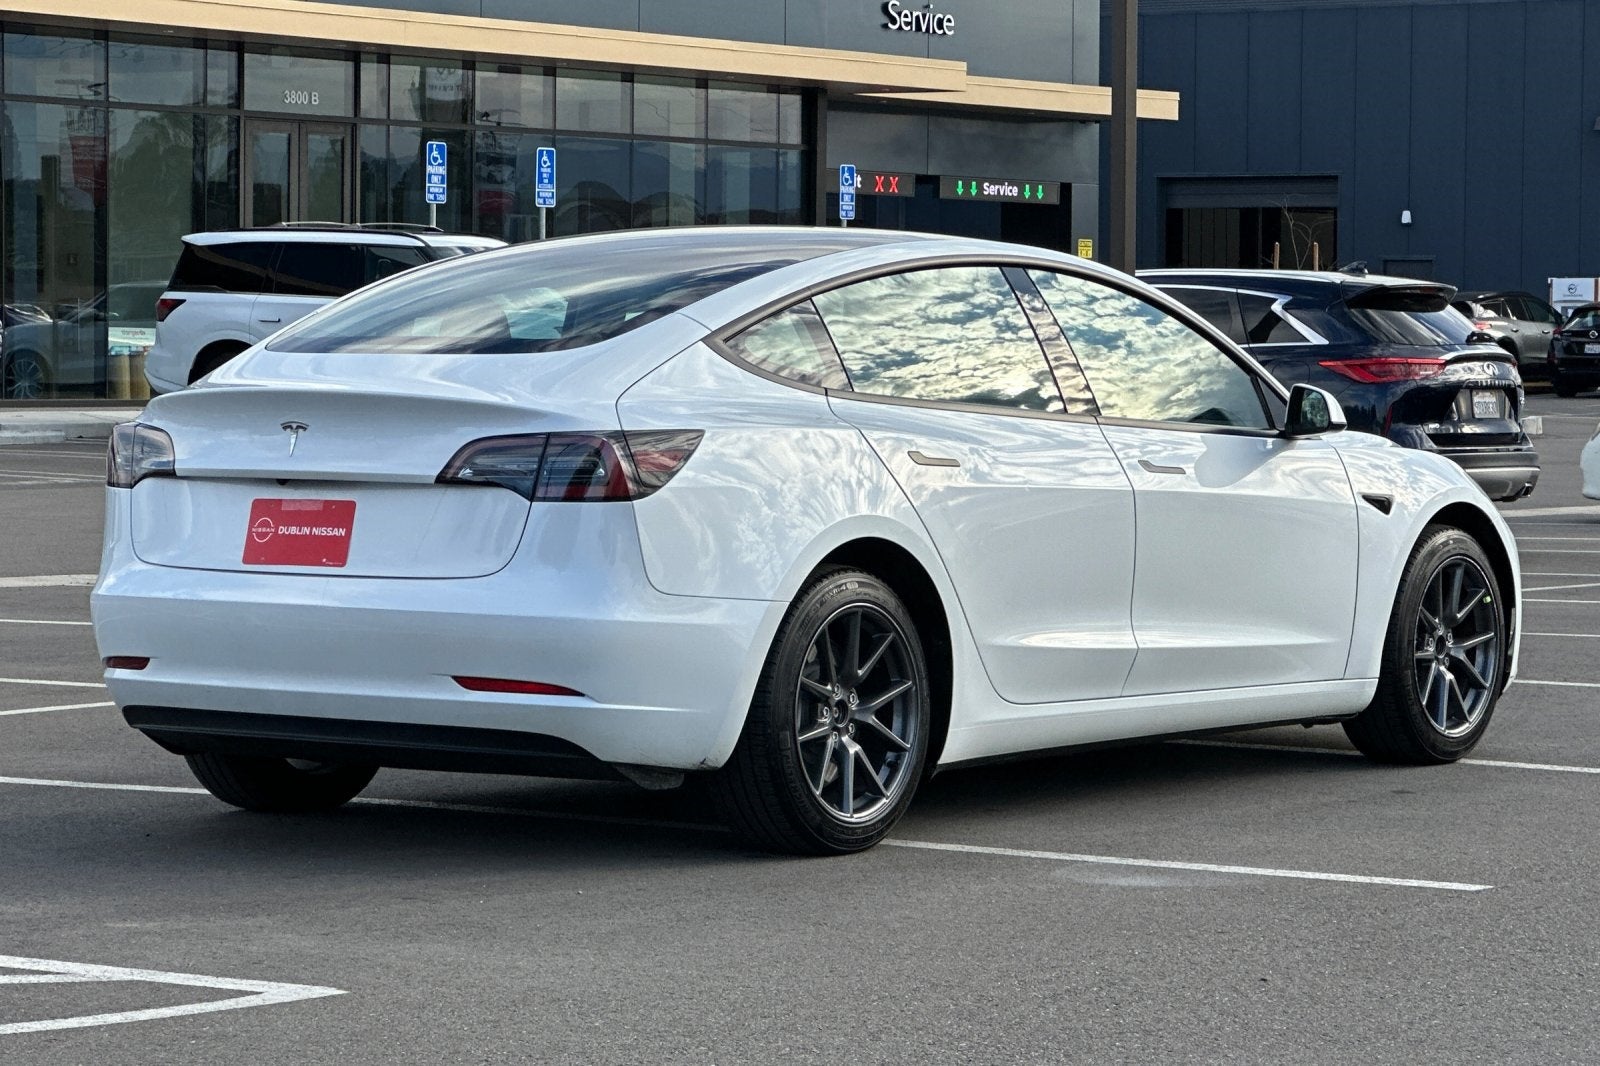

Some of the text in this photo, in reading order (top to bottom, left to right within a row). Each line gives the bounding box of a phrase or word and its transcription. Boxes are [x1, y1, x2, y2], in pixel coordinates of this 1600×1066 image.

[887, 0, 955, 35] Service
[284, 90, 319, 104] 3800 B
[428, 165, 446, 175] PARKING
[430, 174, 442, 184] ONLY
[983, 182, 1018, 196] Service
[278, 526, 346, 536] DUBLIN NISSAN
